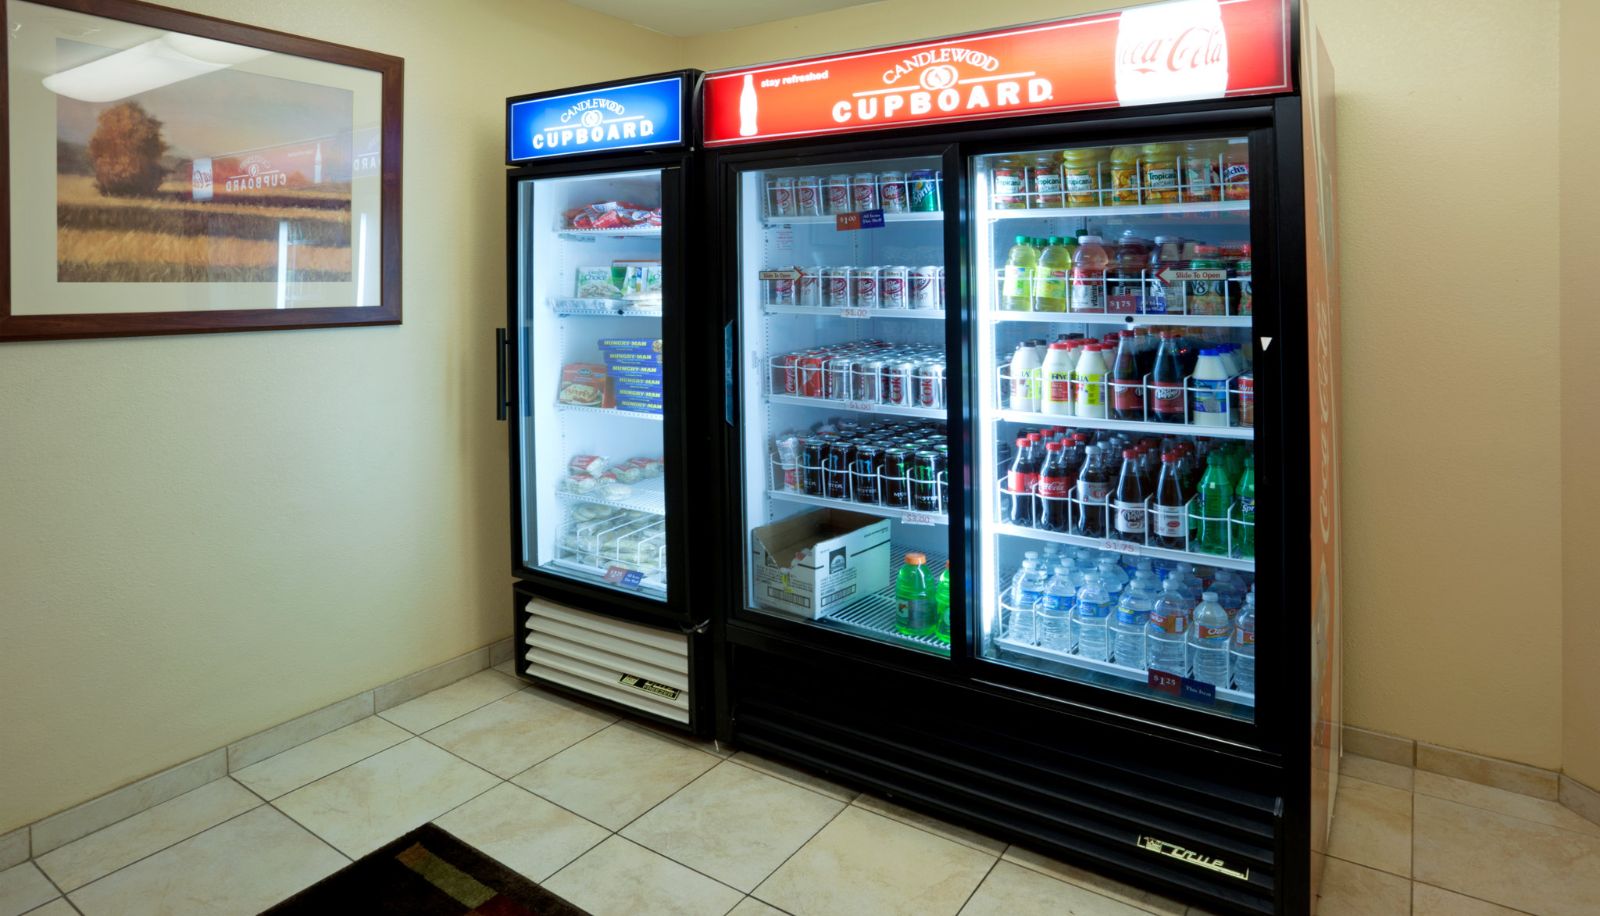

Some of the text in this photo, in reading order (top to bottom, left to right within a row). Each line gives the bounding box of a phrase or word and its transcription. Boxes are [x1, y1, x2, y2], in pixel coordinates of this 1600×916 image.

[761, 69, 829, 88] stay refreshed
[882, 47, 1000, 85] CANDLEWOOD
[560, 98, 625, 123] CANDLEWOOD
[832, 78, 1053, 123] CUPBOARD
[532, 119, 653, 150] CUPBOARD
[1175, 271, 1192, 279] Slide
[1202, 271, 1221, 280] Open
[1316, 289, 1330, 544] Coca-Cola
